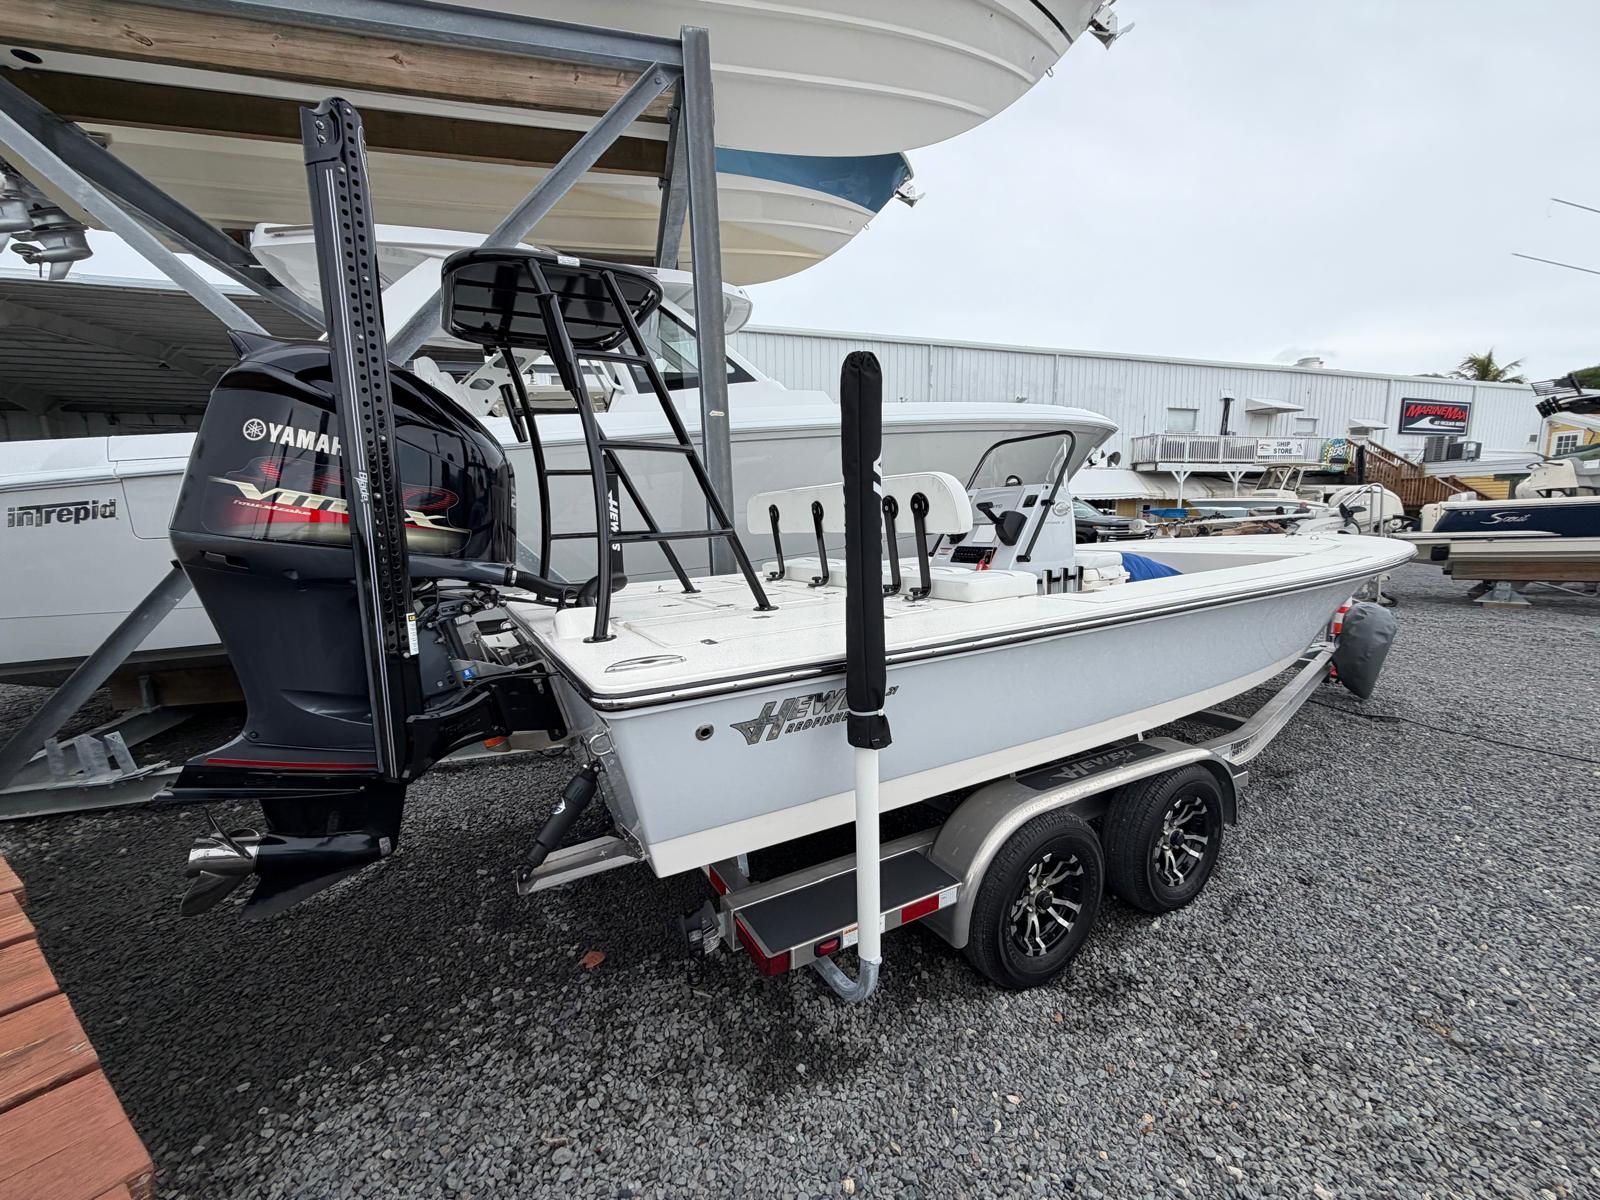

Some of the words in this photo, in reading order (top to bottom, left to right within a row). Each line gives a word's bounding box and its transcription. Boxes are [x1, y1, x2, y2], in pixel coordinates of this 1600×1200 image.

[268, 422, 343, 456] YAMAH
[607, 489, 621, 551] HEWS
[729, 687, 849, 746] HEW
[784, 711, 849, 734] REDFISHE
